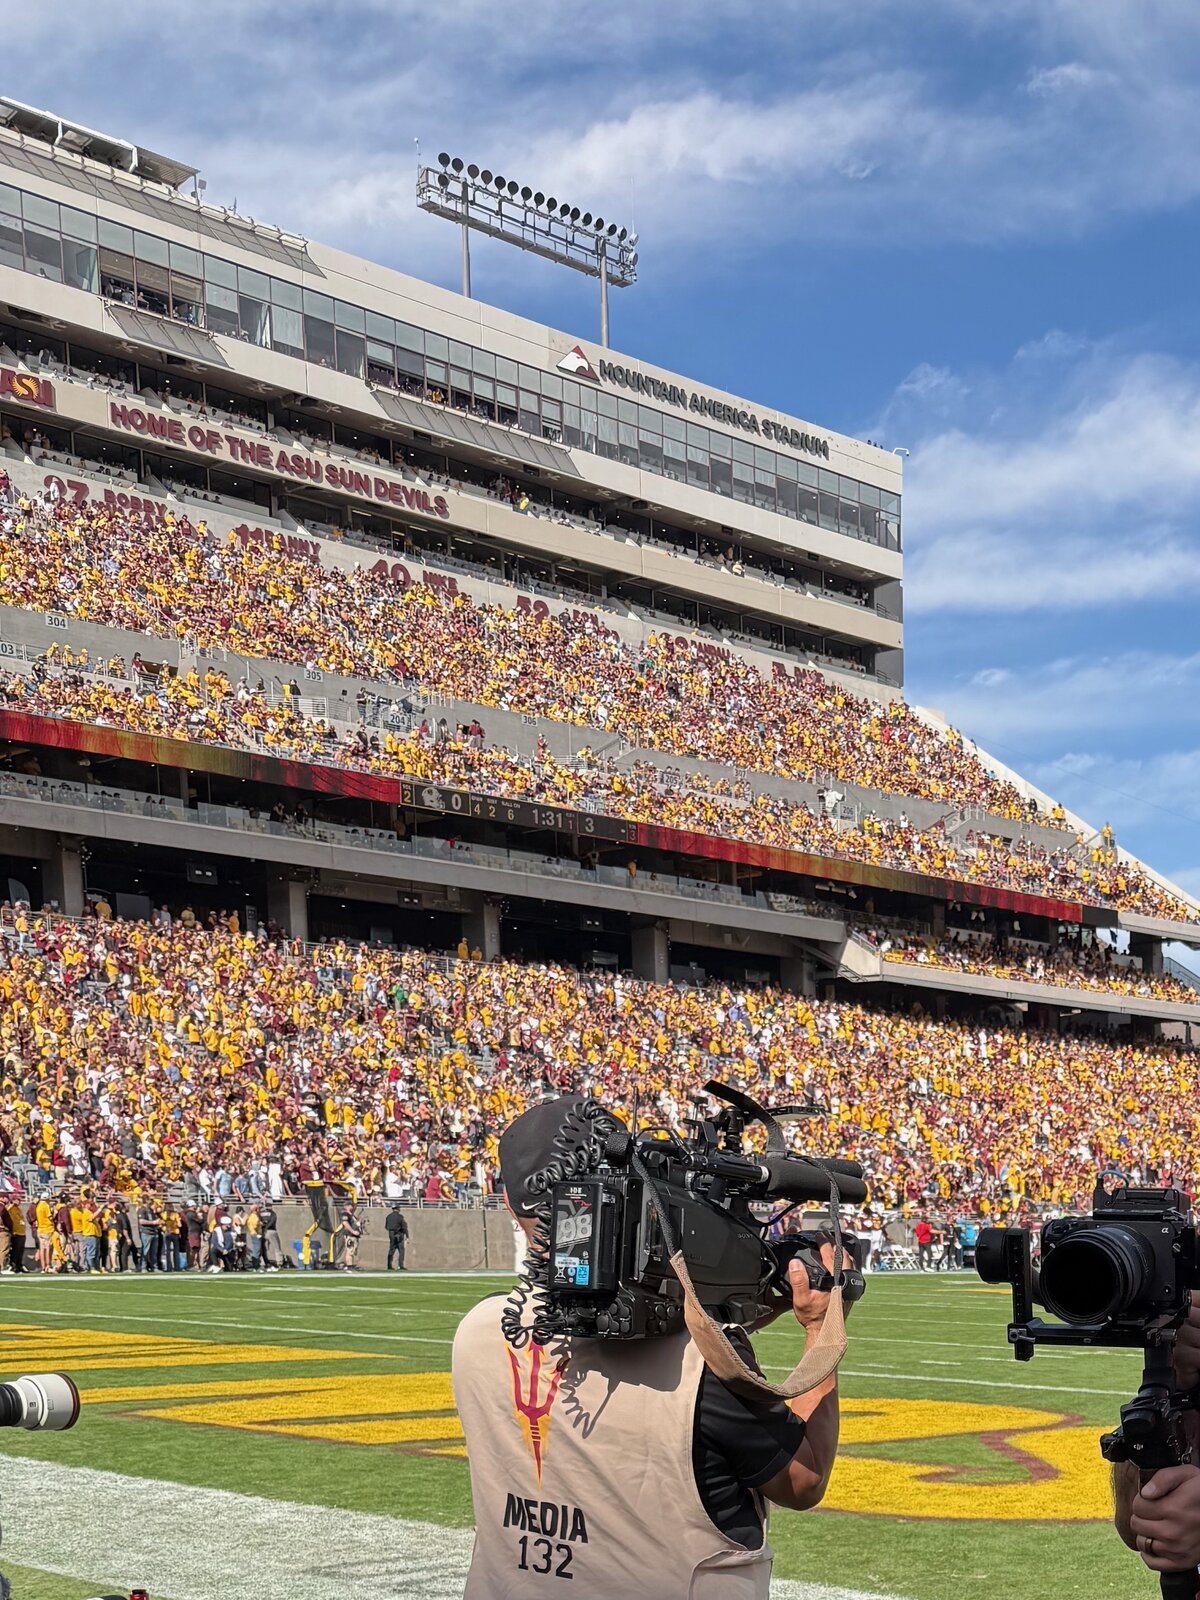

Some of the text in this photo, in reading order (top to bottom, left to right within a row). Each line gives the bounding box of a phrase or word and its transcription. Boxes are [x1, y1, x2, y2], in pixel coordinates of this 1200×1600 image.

[600, 359, 829, 460] MOUNTAIN AMERICA STADIUM
[110, 402, 449, 520] HOME OF THE ASU SUN DEVILS
[47, 615, 66, 628] 304
[306, 670, 322, 681] 305
[390, 714, 406, 726] 204
[523, 715, 537, 726] 306
[403, 791, 412, 804] 2
[451, 793, 462, 811] 0
[474, 803, 480, 816] 4
[488, 806, 496, 818] 2
[507, 809, 515, 820] 6
[532, 809, 562, 829] 1:31
[585, 817, 595, 833] 3
[503, 1492, 589, 1544] MEDIA
[518, 1535, 573, 1580] 132
